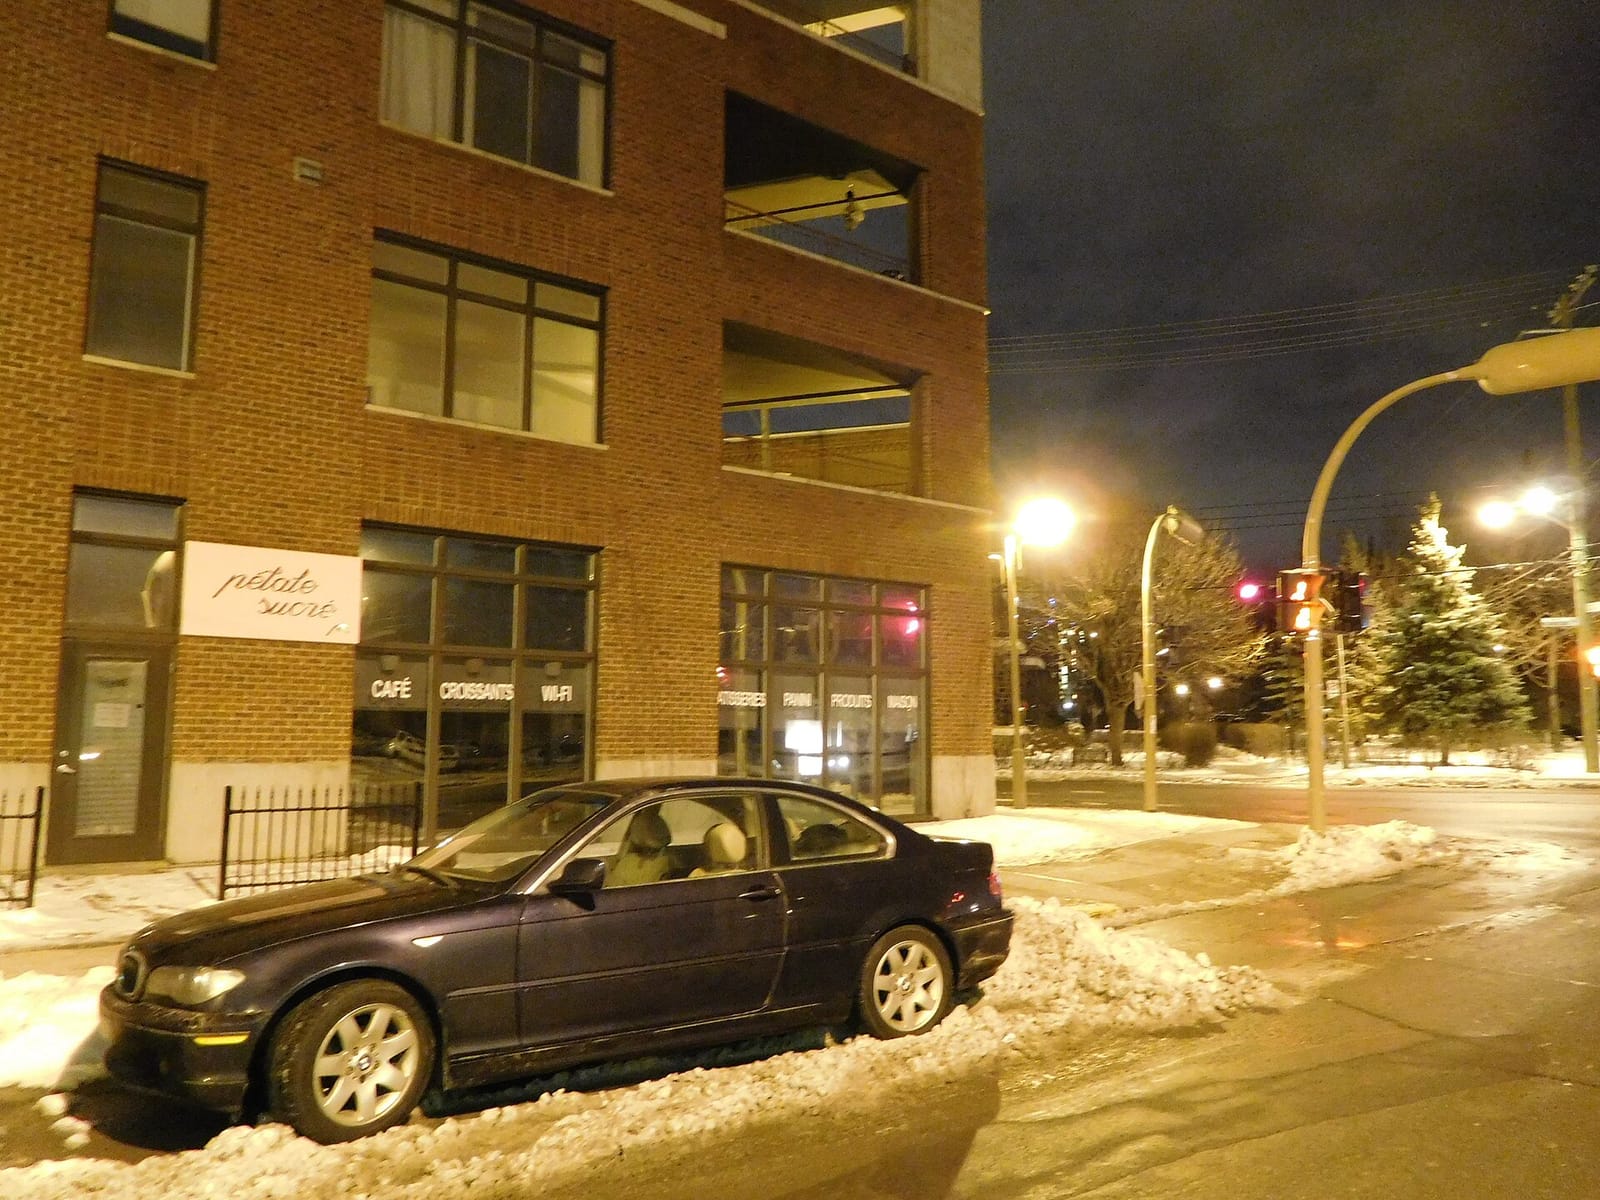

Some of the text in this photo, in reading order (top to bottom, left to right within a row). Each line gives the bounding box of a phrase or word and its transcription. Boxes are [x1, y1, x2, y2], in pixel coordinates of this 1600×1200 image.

[371, 677, 573, 702] CAFÉ CROISSANTS WI-FI
[831, 693, 873, 708] PRODUITS
